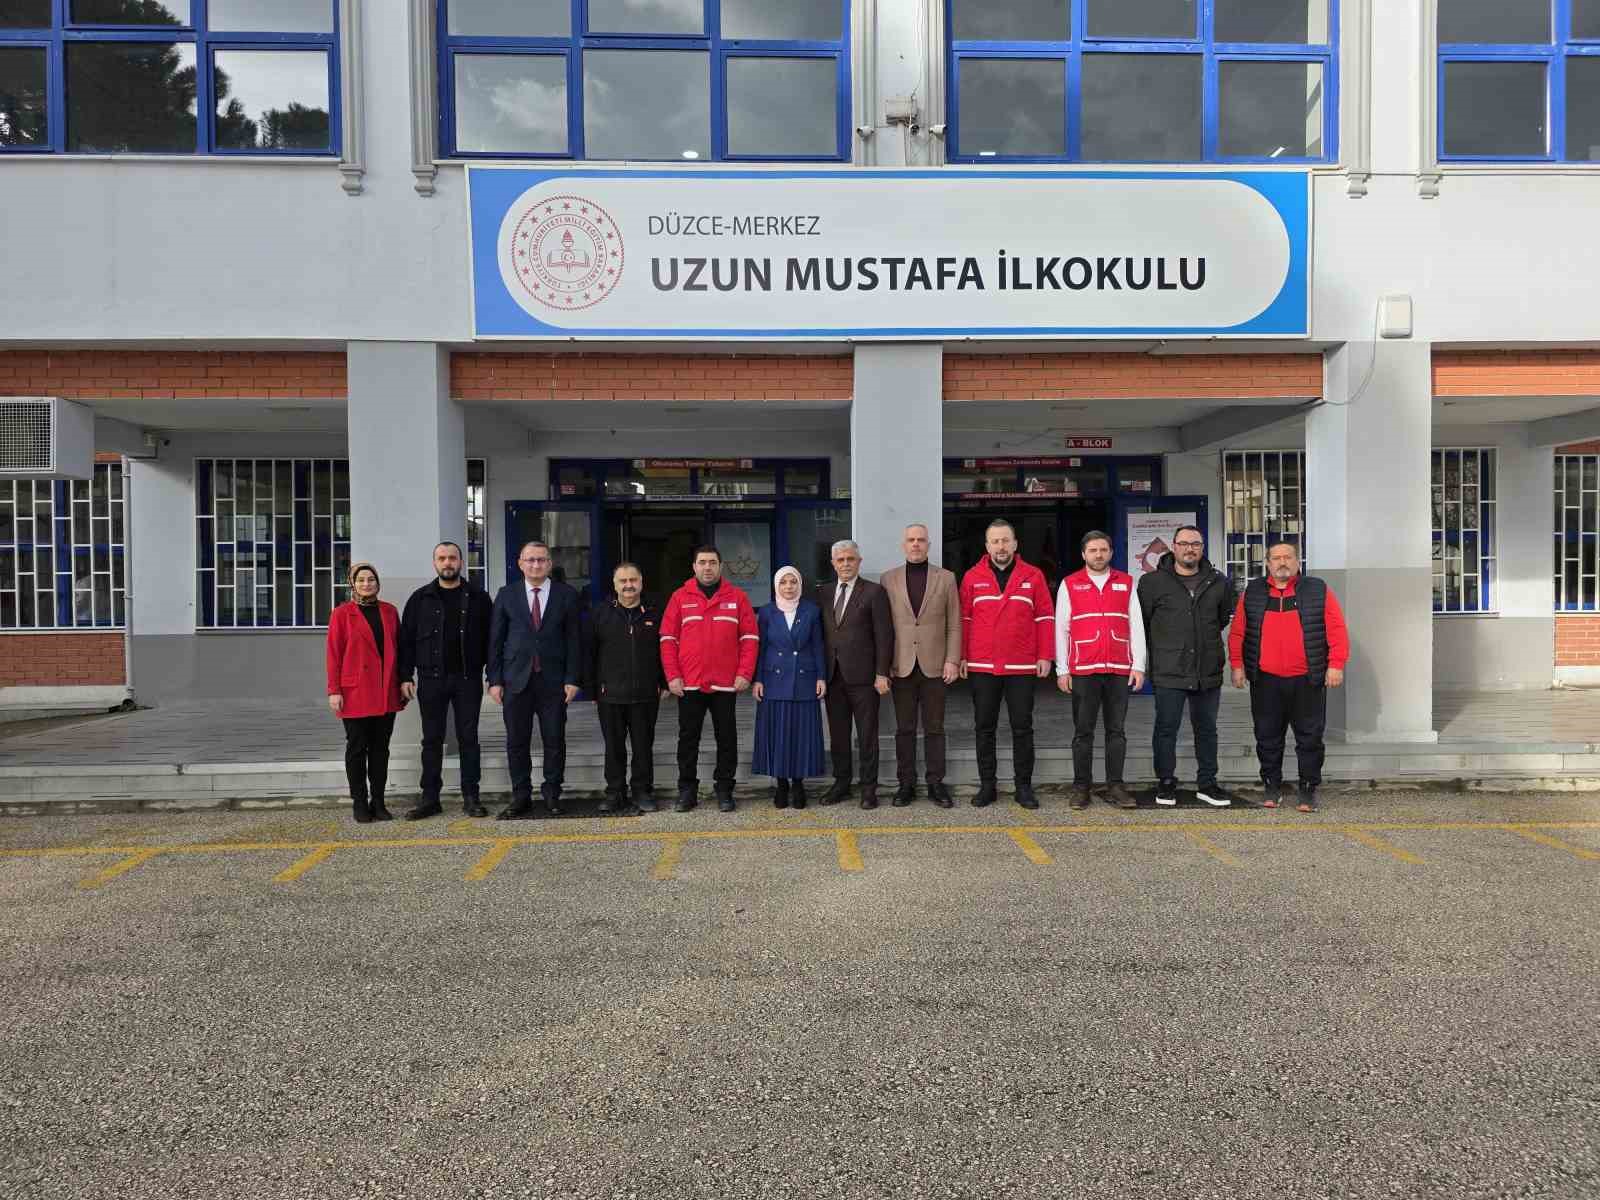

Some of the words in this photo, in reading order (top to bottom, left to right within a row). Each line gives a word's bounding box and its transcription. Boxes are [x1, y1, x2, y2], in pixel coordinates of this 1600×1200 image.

[648, 211, 820, 235] DÜZCE-MERKEZ
[651, 257, 772, 291] UZUN
[785, 256, 985, 291] MUSTAFA
[998, 248, 1205, 290] İLKOKULU
[1068, 439, 1075, 448] A
[1082, 439, 1110, 448] BLOK
